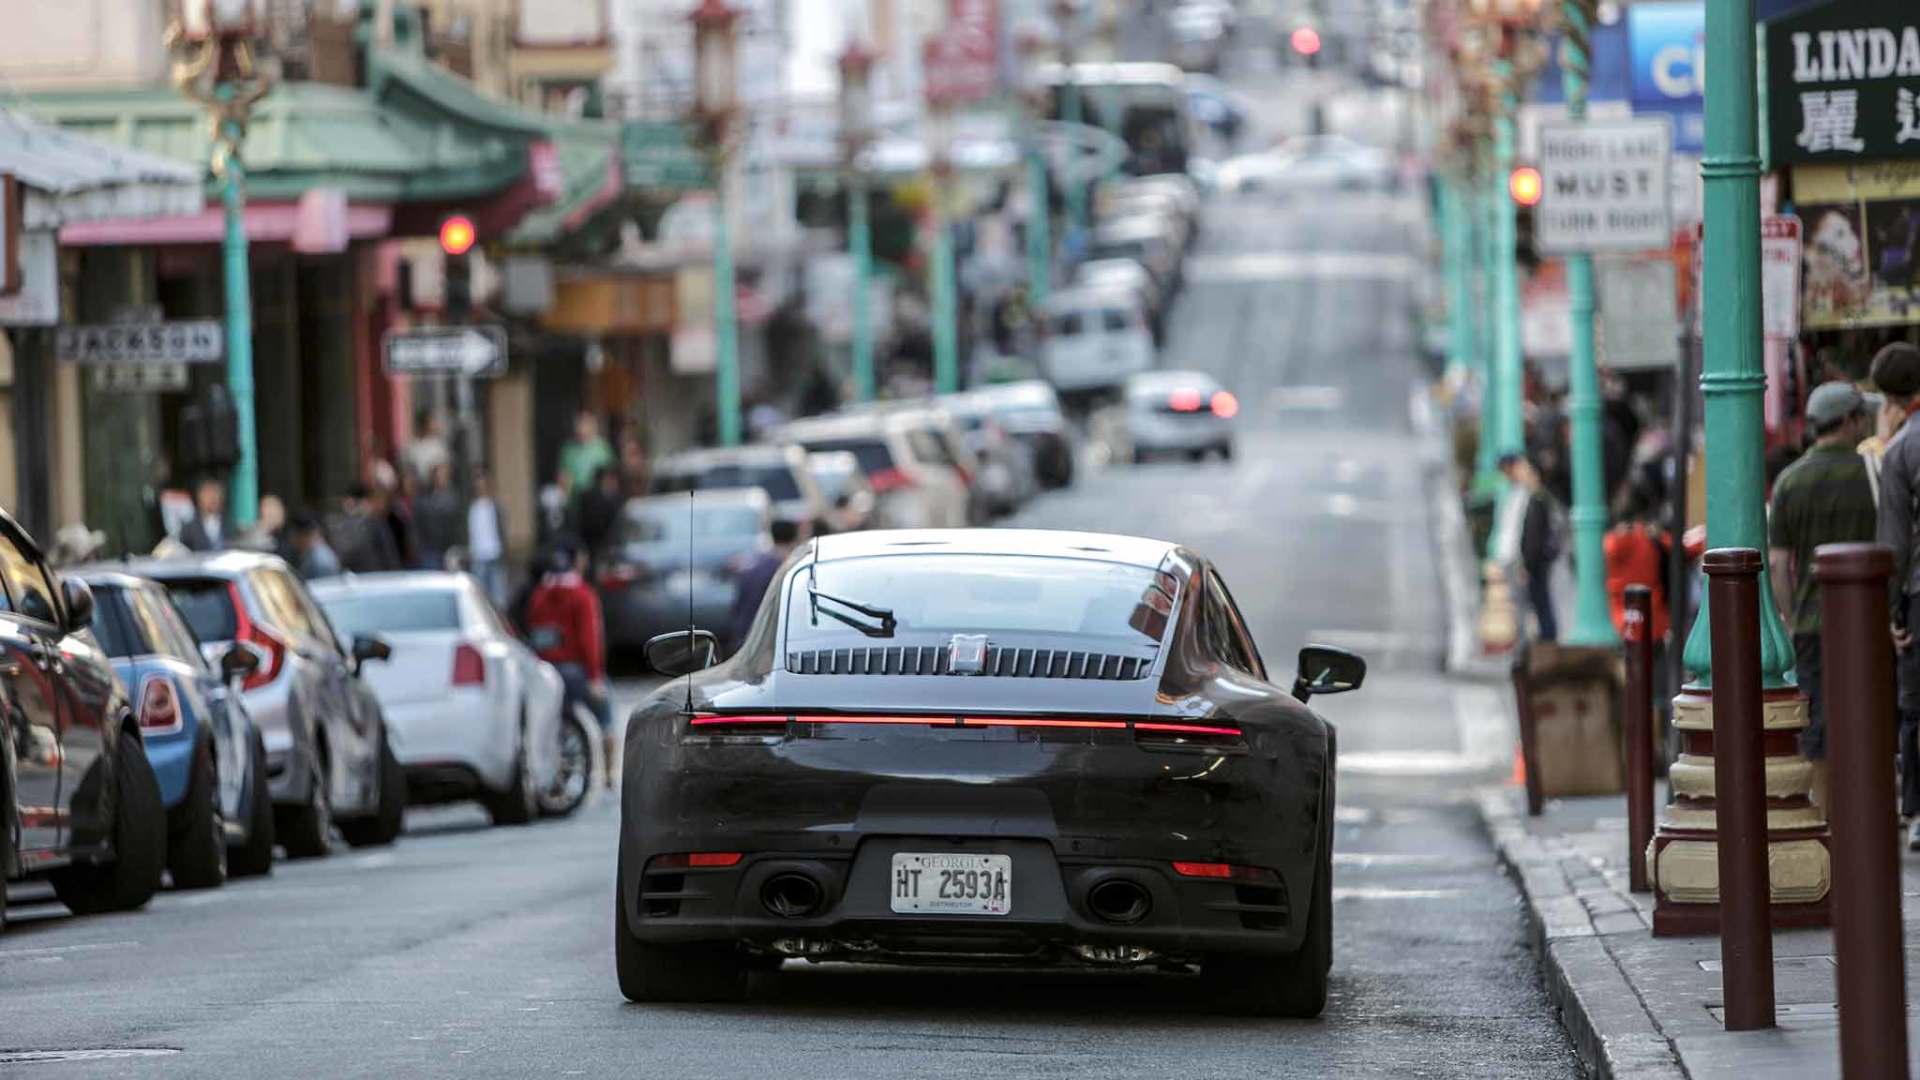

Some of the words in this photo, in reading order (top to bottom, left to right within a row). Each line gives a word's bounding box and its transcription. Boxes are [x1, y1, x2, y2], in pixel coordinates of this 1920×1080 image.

[1791, 26, 1920, 82] LINDA
[1554, 171, 1652, 198] MUST
[60, 326, 213, 358] JACKSON
[921, 857, 991, 869] GEORGIA
[897, 869, 922, 898] HT
[939, 869, 1005, 901] 2593A
